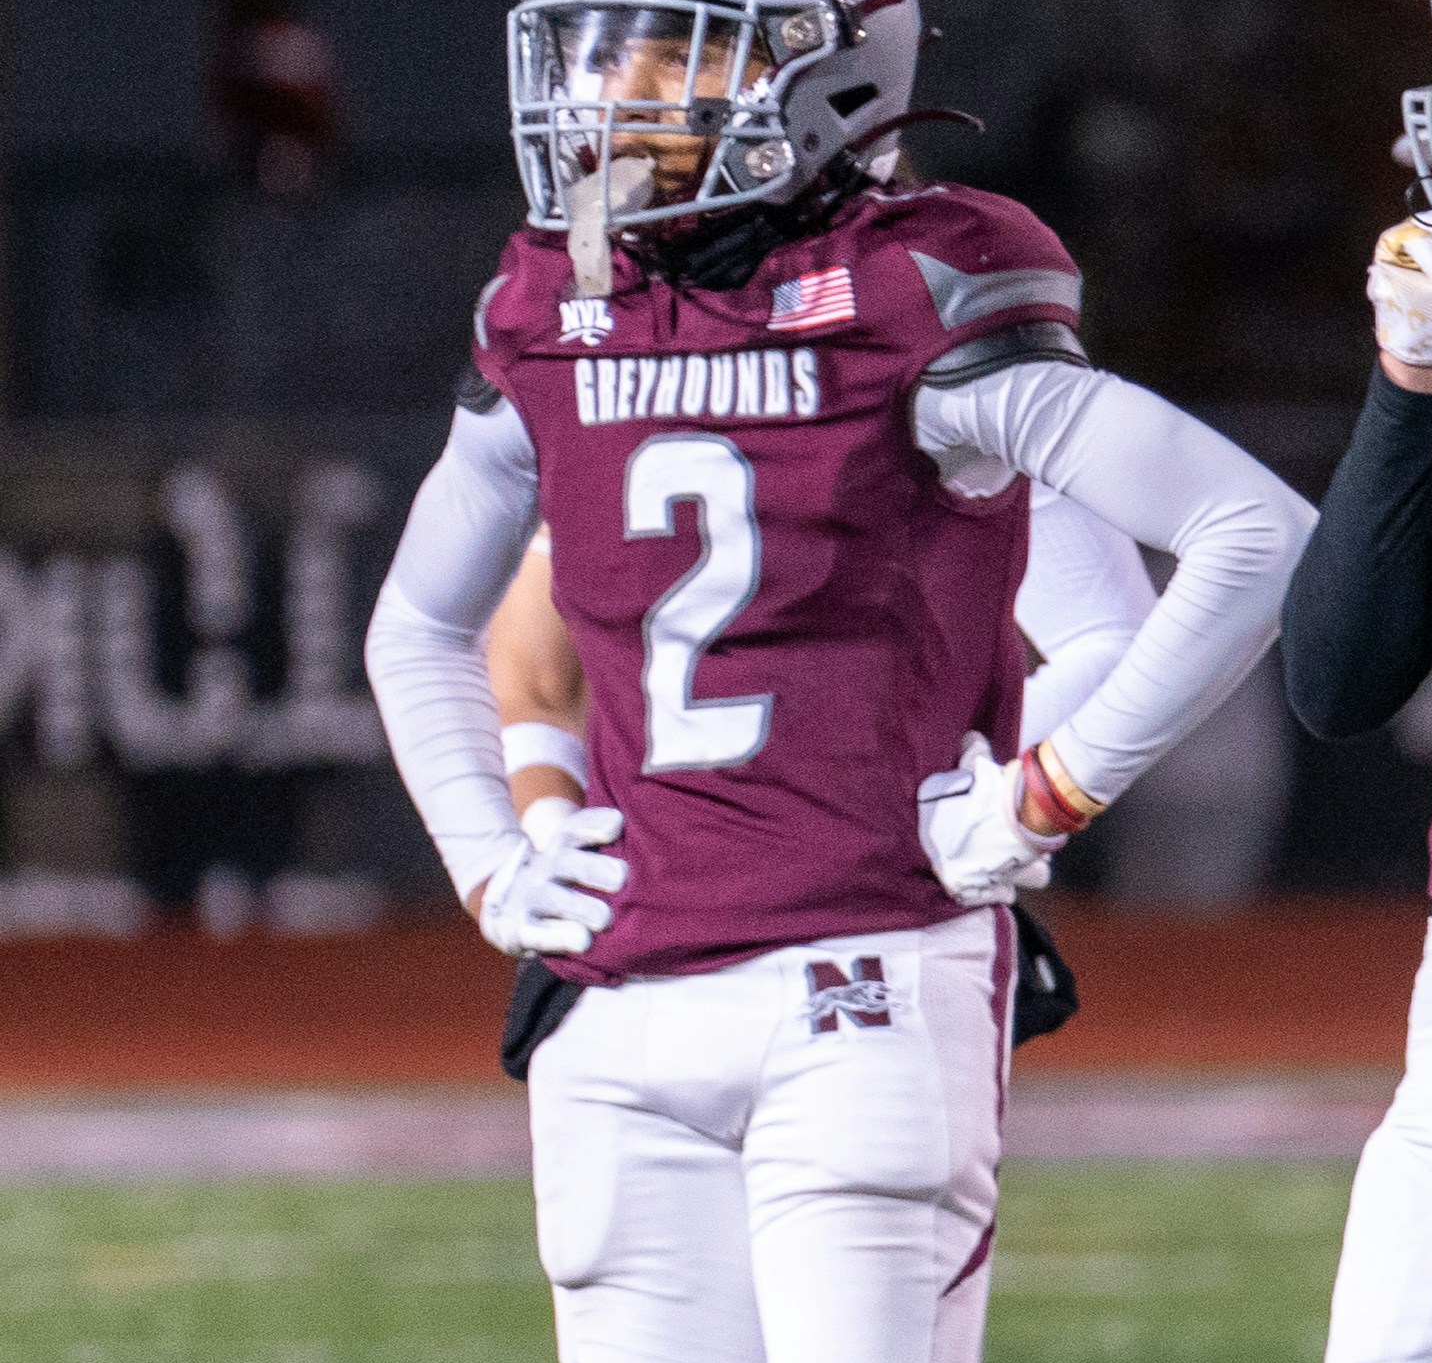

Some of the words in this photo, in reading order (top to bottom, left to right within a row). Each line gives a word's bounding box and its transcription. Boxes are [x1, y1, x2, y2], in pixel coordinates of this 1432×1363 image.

[559, 298, 615, 334] NVL
[575, 347, 820, 426] GREYHOUNDS
[623, 432, 774, 774] 2
[803, 956, 891, 1035] N
